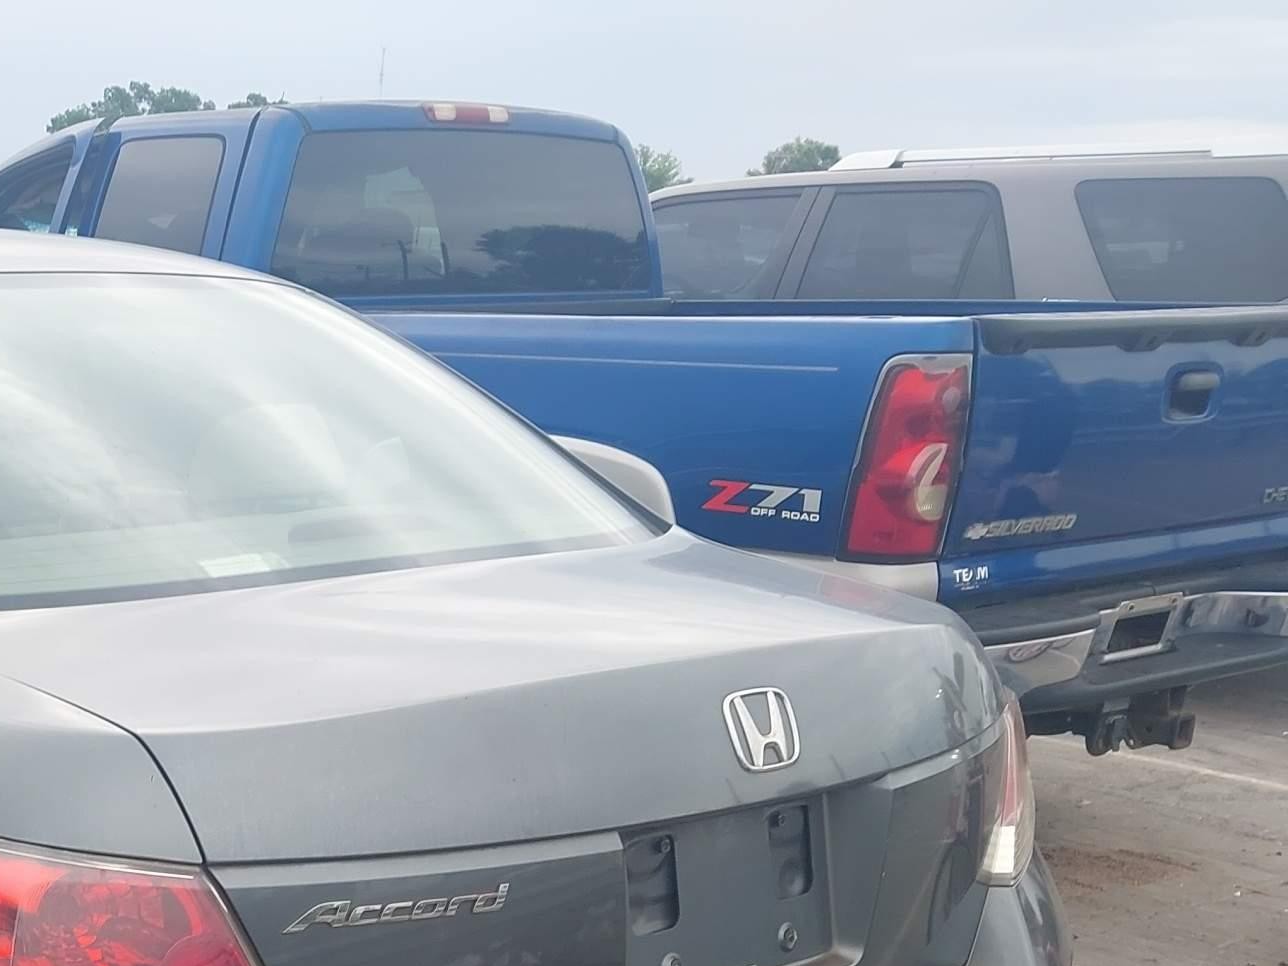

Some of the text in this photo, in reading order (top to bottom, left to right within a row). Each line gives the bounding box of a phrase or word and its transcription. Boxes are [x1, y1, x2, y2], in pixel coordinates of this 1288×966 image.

[701, 480, 822, 513] Z71
[750, 507, 820, 522] OFF ROAD
[985, 514, 1077, 537] SILVERADO
[281, 882, 510, 935] Accord
